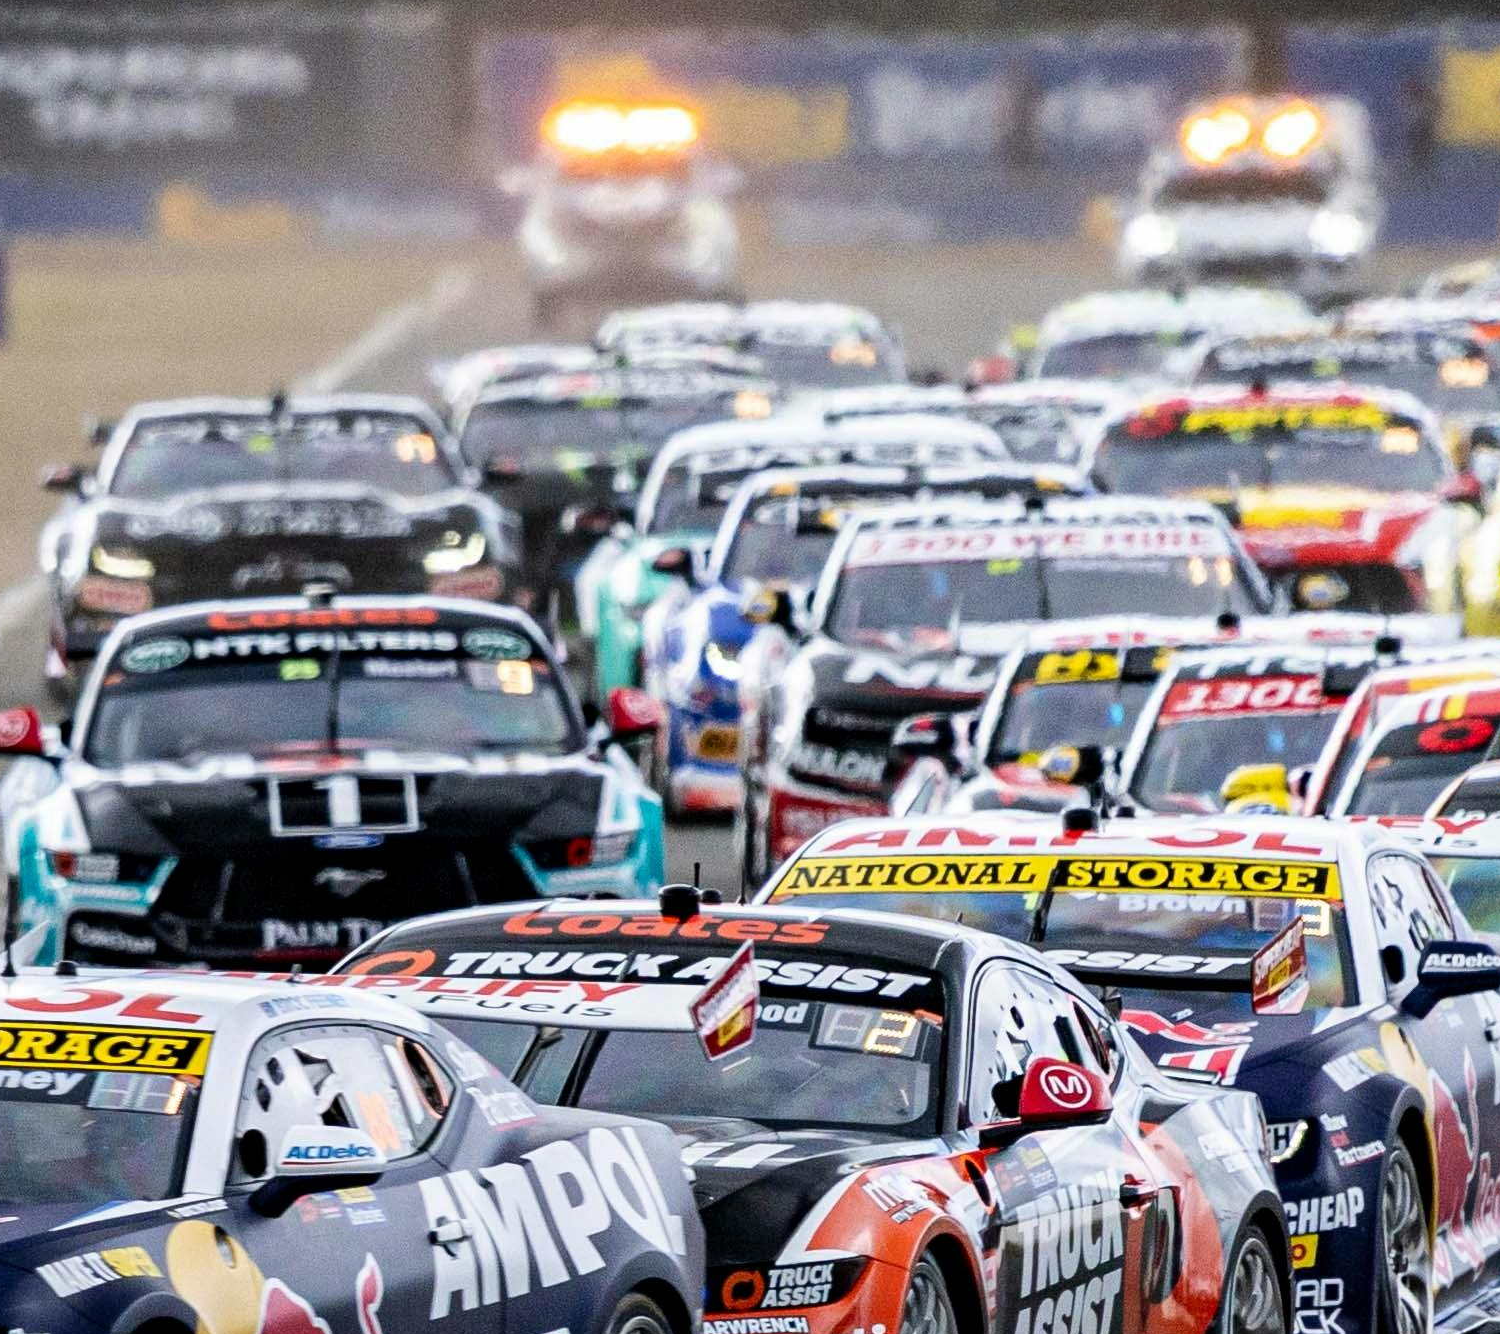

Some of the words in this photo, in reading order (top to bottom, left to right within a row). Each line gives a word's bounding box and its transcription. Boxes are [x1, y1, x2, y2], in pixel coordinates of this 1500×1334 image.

[788, 862, 1039, 891] NATIONAL
[1066, 860, 1320, 893] STORAGE
[502, 912, 830, 945] Coates
[443, 951, 679, 980] TRUCK
[429, 993, 615, 1018] Fuels
[754, 1002, 809, 1024] ood
[863, 1011, 918, 1054] 2
[419, 1126, 687, 1321] AMPOL
[1016, 1170, 1125, 1298] TRUCK
[767, 1263, 835, 1289] TRUCK
[760, 1283, 833, 1309] ASSIST
